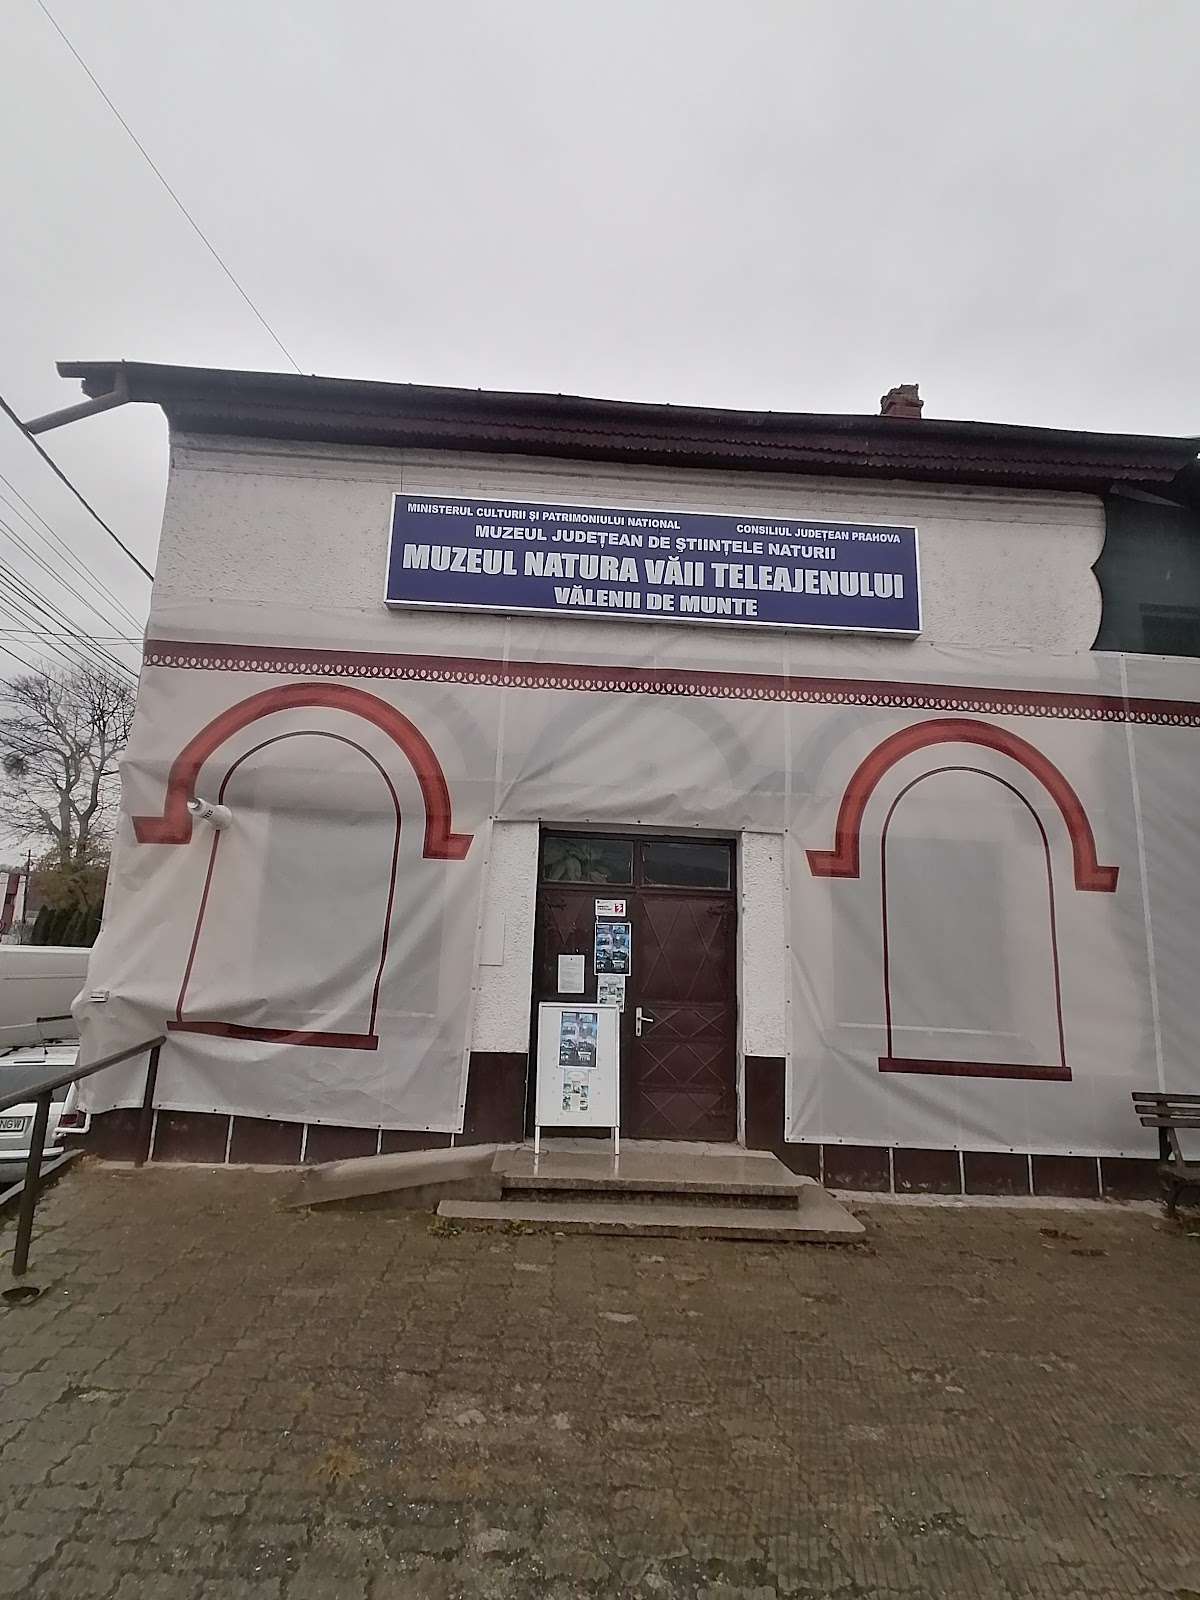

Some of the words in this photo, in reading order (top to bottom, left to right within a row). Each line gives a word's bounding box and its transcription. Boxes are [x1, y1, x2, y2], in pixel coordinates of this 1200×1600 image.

[407, 503, 474, 516] MINISTERUL
[476, 507, 526, 520] CULTURII
[542, 512, 625, 526] PATRIMONIULUI
[627, 517, 681, 530] NATIONAL
[475, 525, 547, 541] MUZEUL
[648, 535, 671, 549] DE
[768, 542, 836, 560] NATURII
[736, 524, 792, 537] CONSILIUL
[851, 532, 901, 544] PRAHOVA
[402, 543, 518, 575] MUZEUL
[524, 551, 639, 583] NATURA
[644, 555, 704, 587] VĂII
[711, 562, 904, 599] TELEAJENULUI
[554, 584, 641, 609] VĂLENII
[646, 593, 675, 611] DE
[679, 595, 758, 616] MUNTE
